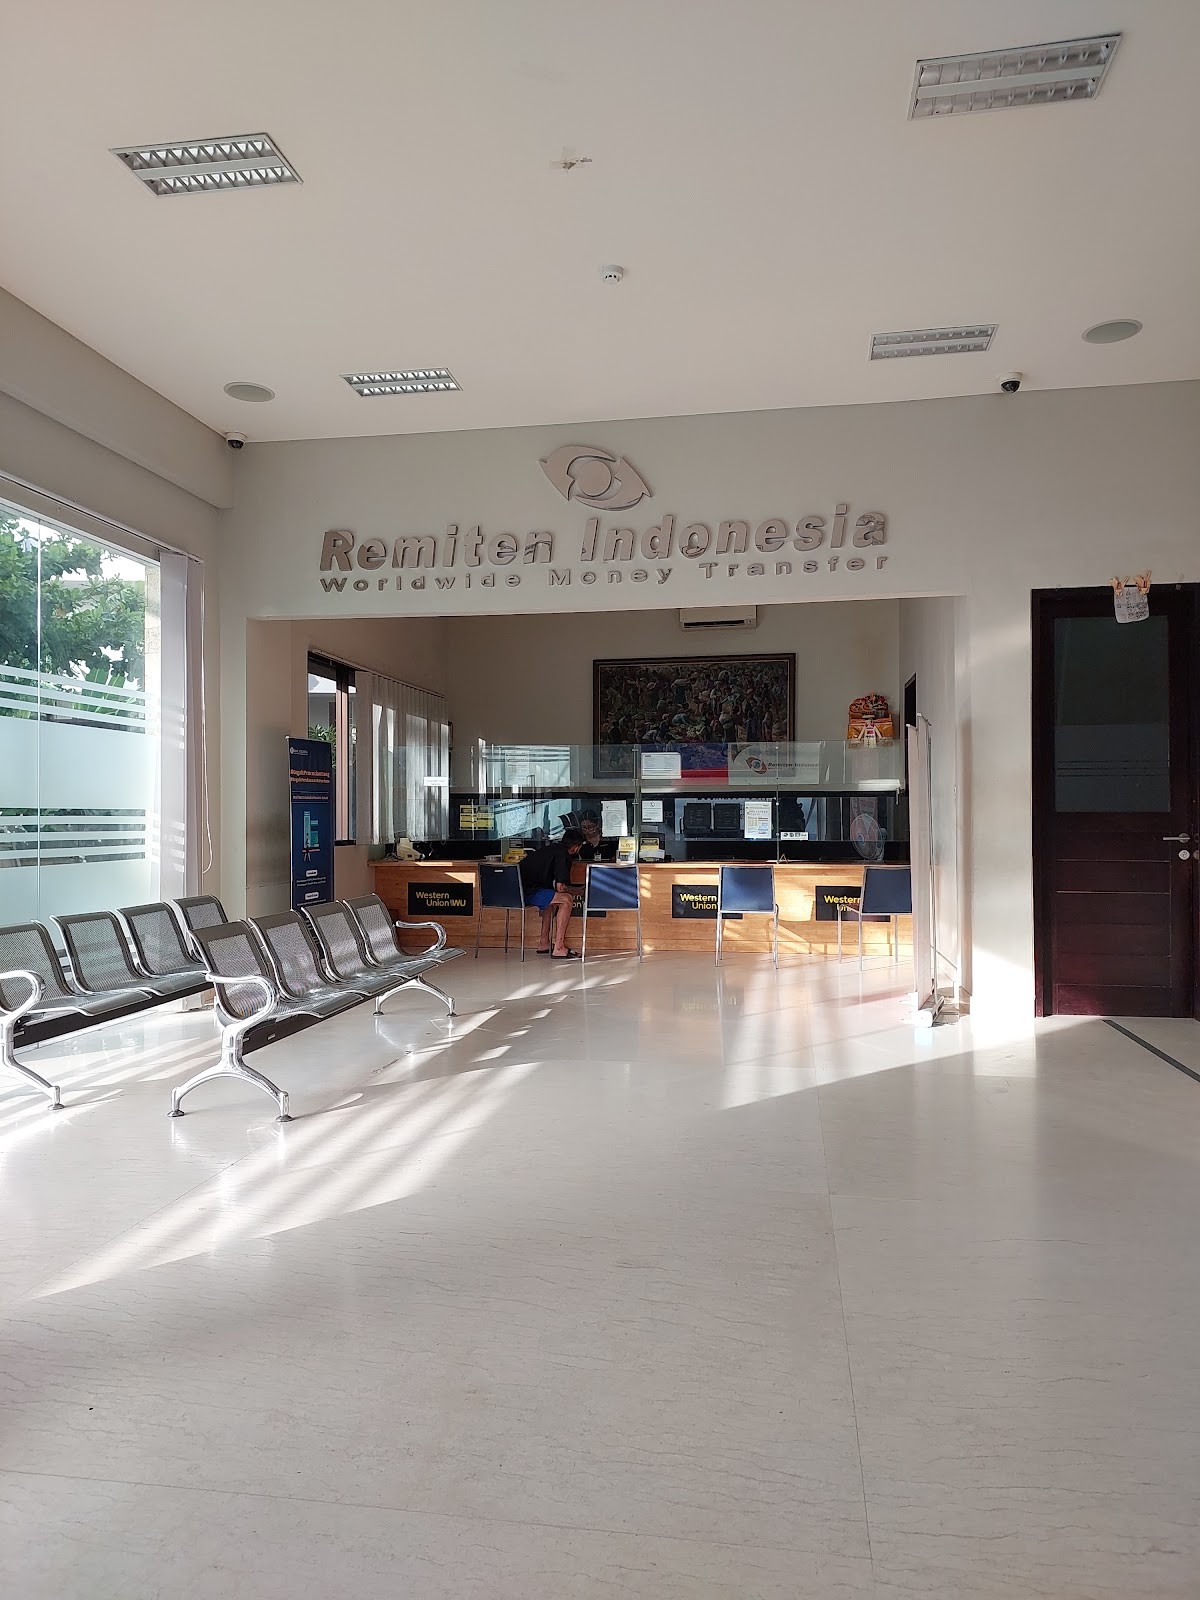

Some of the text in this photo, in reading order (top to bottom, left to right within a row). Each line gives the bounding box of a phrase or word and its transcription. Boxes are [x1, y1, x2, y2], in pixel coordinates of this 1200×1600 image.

[319, 503, 887, 572] Remiten Indonesia
[319, 556, 888, 593] Worldwide Money Transfer
[415, 891, 450, 899] Western
[679, 893, 717, 902] Western
[426, 899, 450, 907] Union
[691, 901, 717, 910] Union
